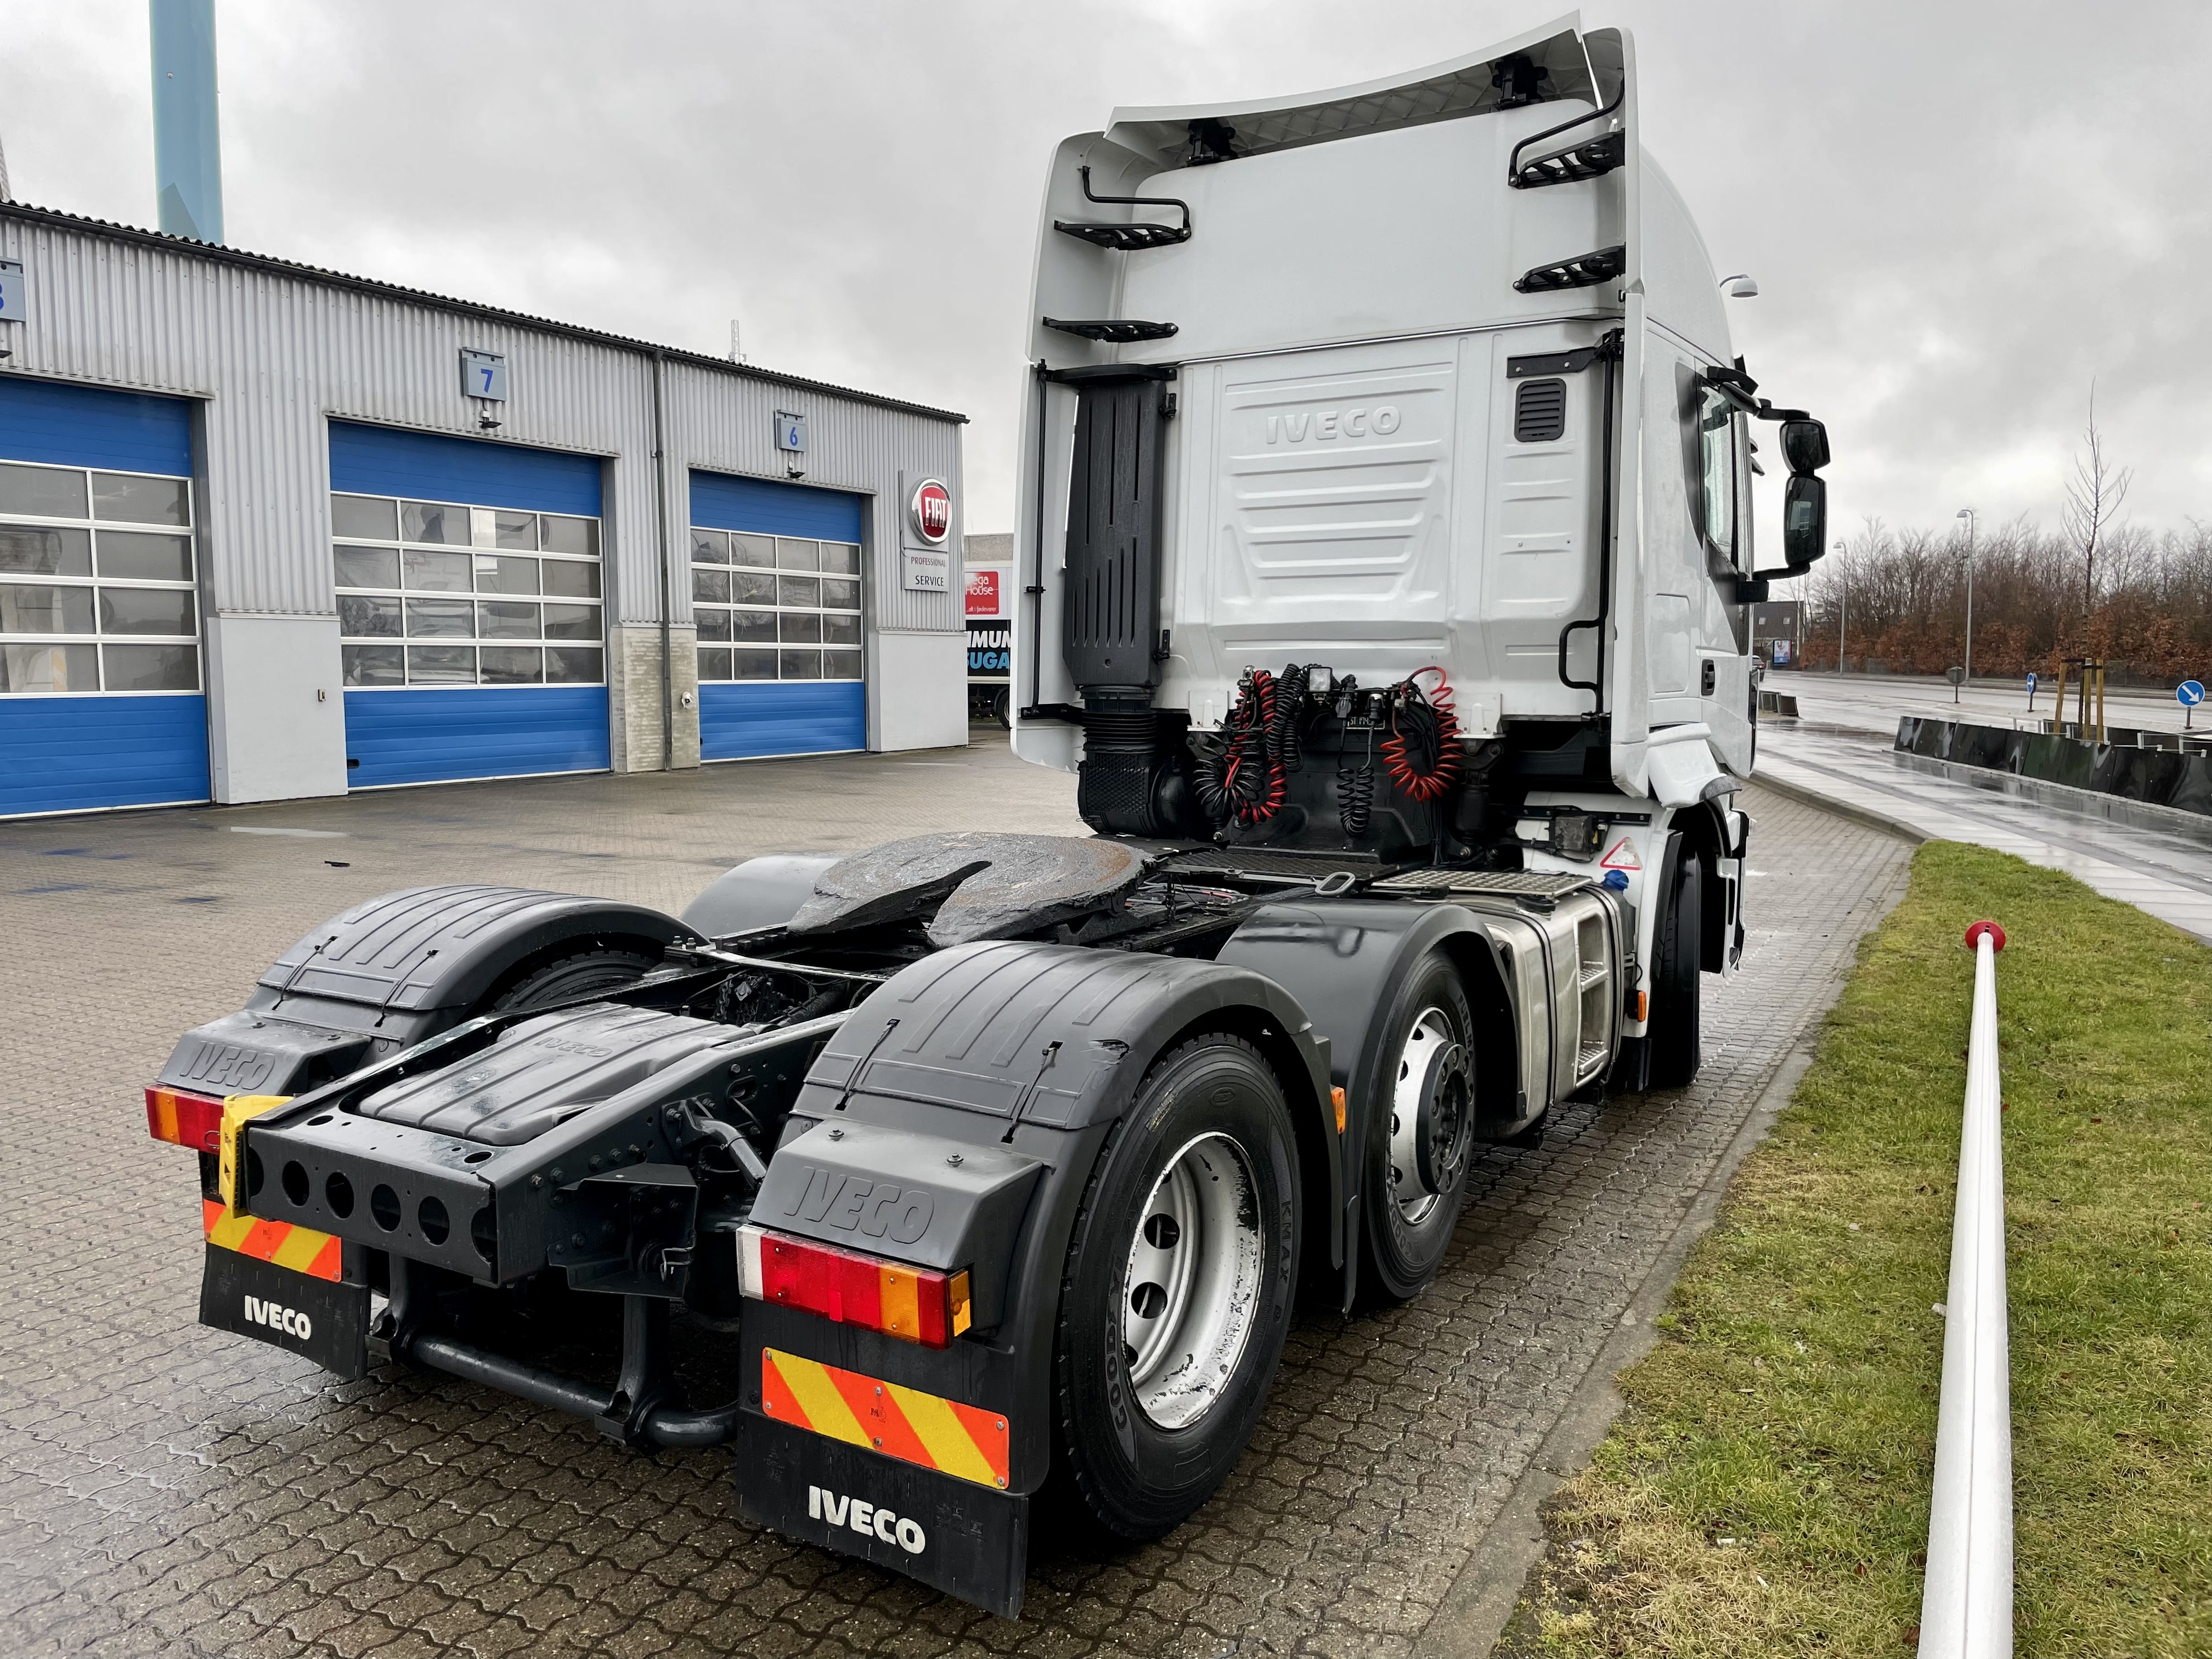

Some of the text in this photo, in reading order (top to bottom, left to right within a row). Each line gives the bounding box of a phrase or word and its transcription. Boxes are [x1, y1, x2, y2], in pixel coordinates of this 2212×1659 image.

[481, 368, 493, 393] 7
[790, 427, 798, 447] 6
[1266, 406, 1401, 444] IVECO
[924, 496, 947, 528] FIAT
[911, 556, 946, 567] PROFESSIONAL
[915, 575, 944, 586] SERVICE
[967, 576, 989, 588] ega
[967, 652, 1010, 669] UGA
[533, 1037, 613, 1058] IVECO
[179, 1040, 275, 1090] IVECO
[783, 1166, 934, 1244] IVECO
[1279, 1200, 1291, 1285] KMAX
[245, 1295, 312, 1340] IVECO
[809, 1485, 926, 1554] IVECO
